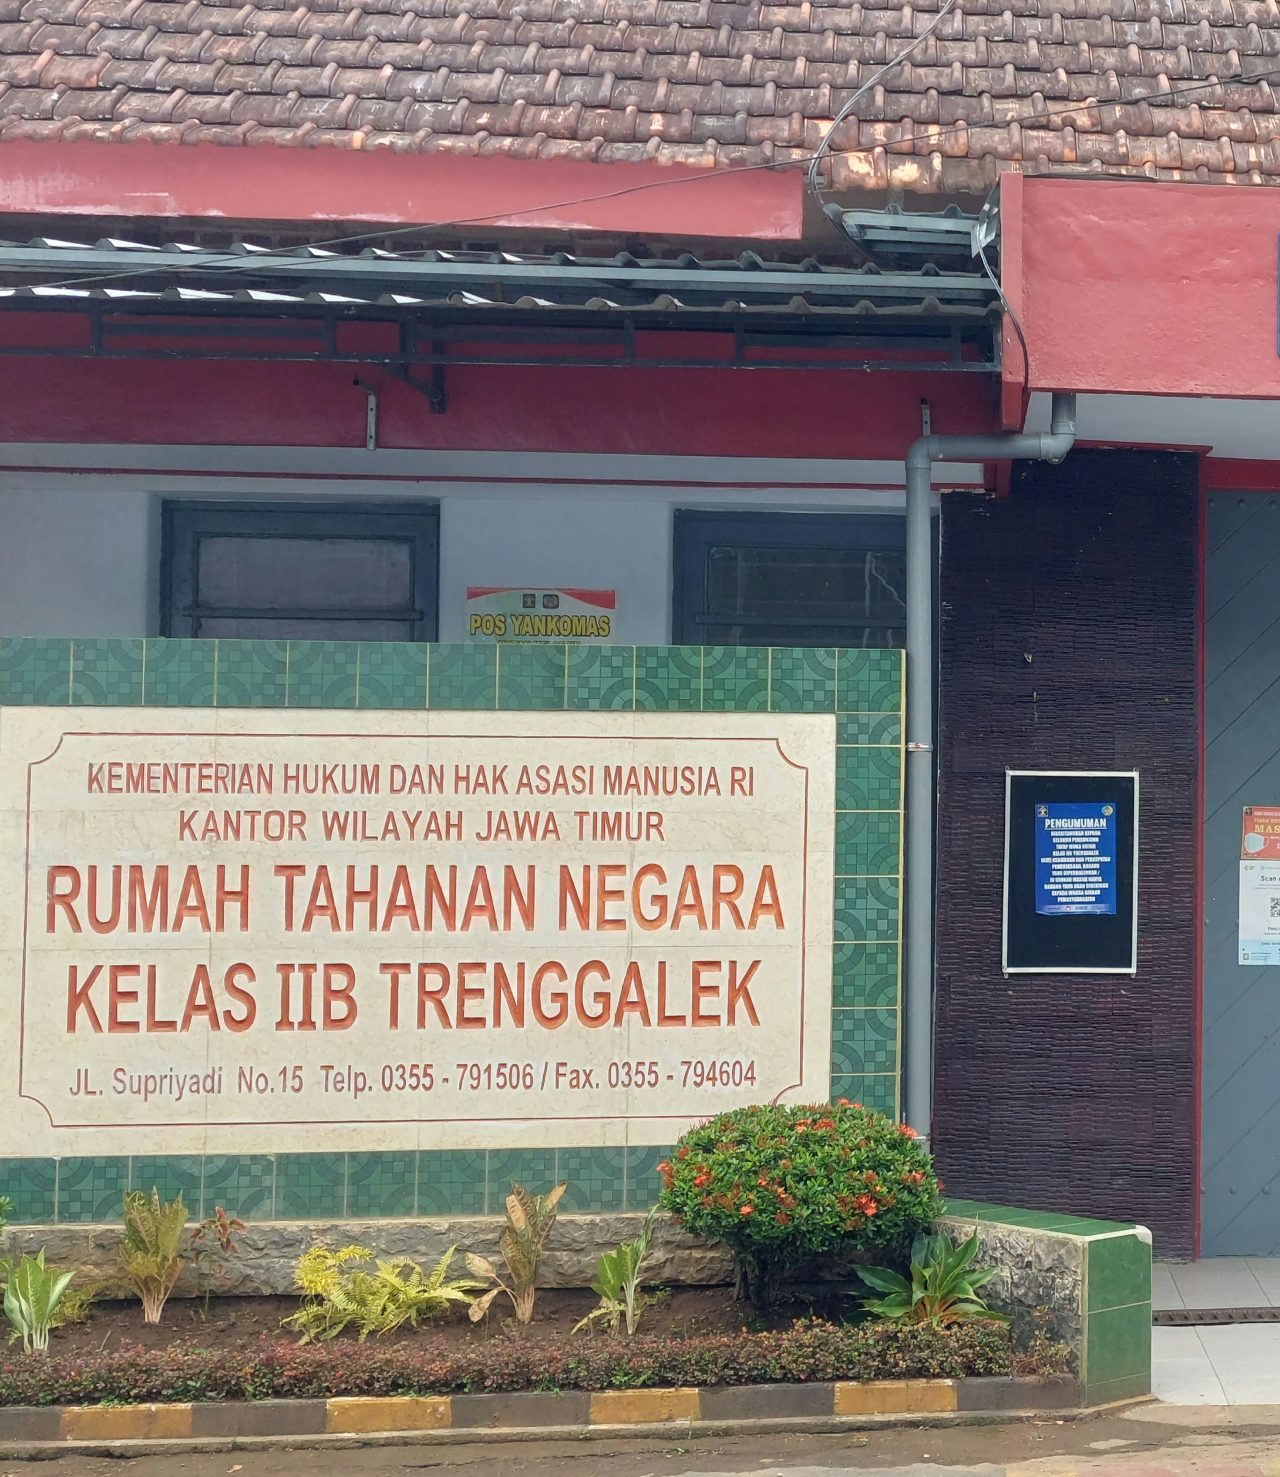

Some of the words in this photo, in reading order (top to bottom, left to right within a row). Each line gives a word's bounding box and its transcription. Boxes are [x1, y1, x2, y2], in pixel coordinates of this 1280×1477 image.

[470, 614, 506, 636] POS
[510, 614, 611, 637] YANKOMAS
[88, 762, 273, 795] KEMENTERIAN
[284, 764, 380, 795] HUKUM
[389, 764, 444, 795] DAN
[454, 764, 508, 795] HAK
[516, 764, 594, 796] ASASI
[603, 765, 722, 796] MANUSIA
[730, 766, 754, 796] RI
[179, 810, 307, 842] KANTOR
[322, 810, 463, 841] WILAYAH
[475, 810, 561, 841] JAWA
[574, 810, 666, 841] TIMUR
[1045, 818, 1107, 828] PENGUMUMAN
[46, 865, 250, 934] RUMAH
[274, 864, 535, 932] TAHANAN
[558, 863, 785, 931] NEGARA
[66, 963, 257, 1033] KELAS
[275, 963, 357, 1031] IIB
[379, 960, 762, 1030] TRENGGALEK
[69, 1068, 103, 1096] JL.
[112, 1066, 223, 1102] Supriyadi
[238, 1065, 304, 1094] No.15
[320, 1065, 373, 1098] Telp.
[381, 1063, 434, 1092] 0355
[456, 1062, 534, 1090] 791506
[555, 1061, 599, 1090] Fax.
[607, 1061, 659, 1088] 0355
[680, 1060, 756, 1087] 794604
